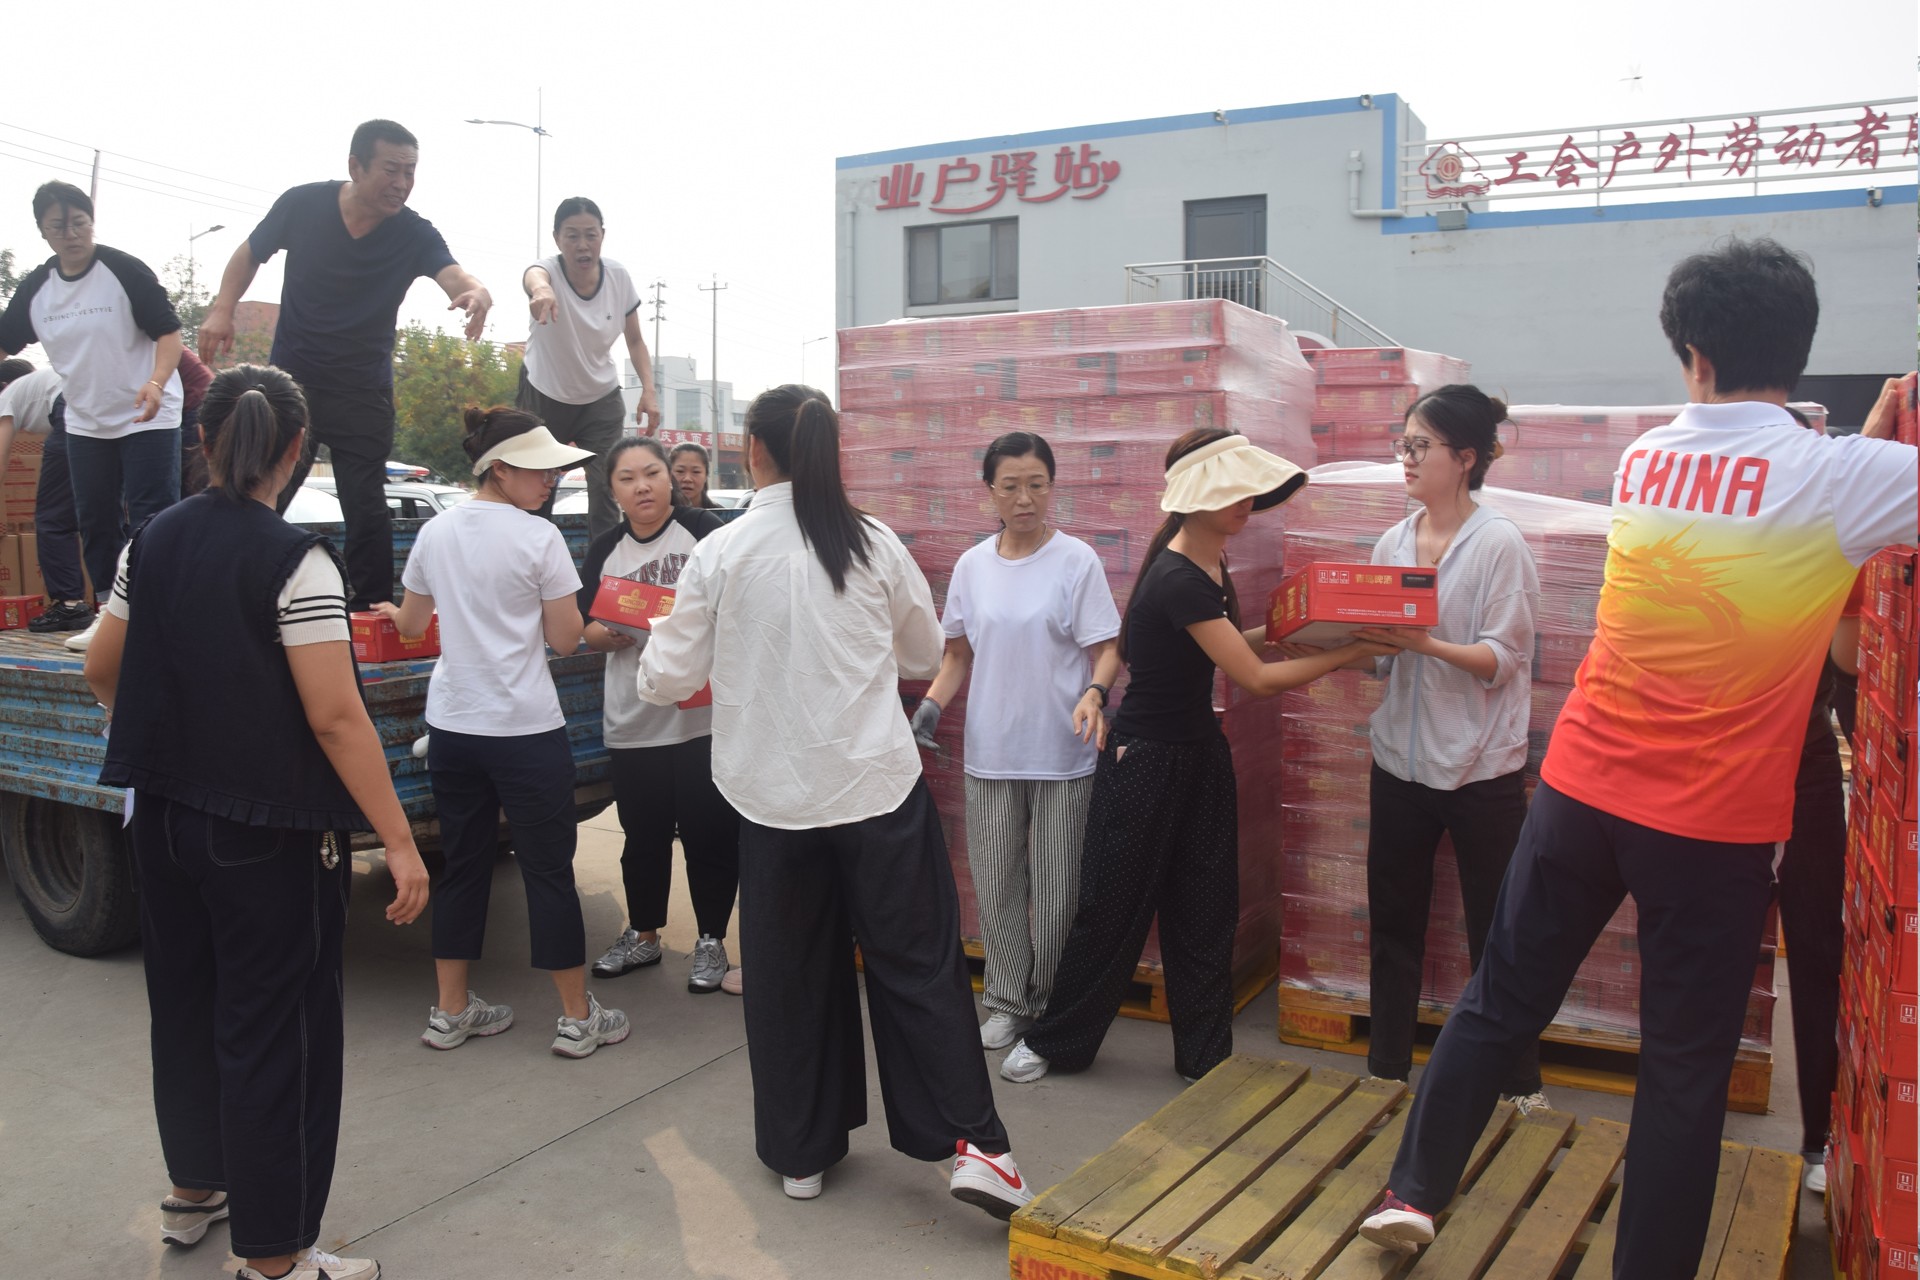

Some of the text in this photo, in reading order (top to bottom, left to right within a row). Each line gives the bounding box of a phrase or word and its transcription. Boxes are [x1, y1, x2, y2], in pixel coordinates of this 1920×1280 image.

[875, 143, 1109, 214] 业户驿站
[1619, 449, 1770, 517] CHINA
